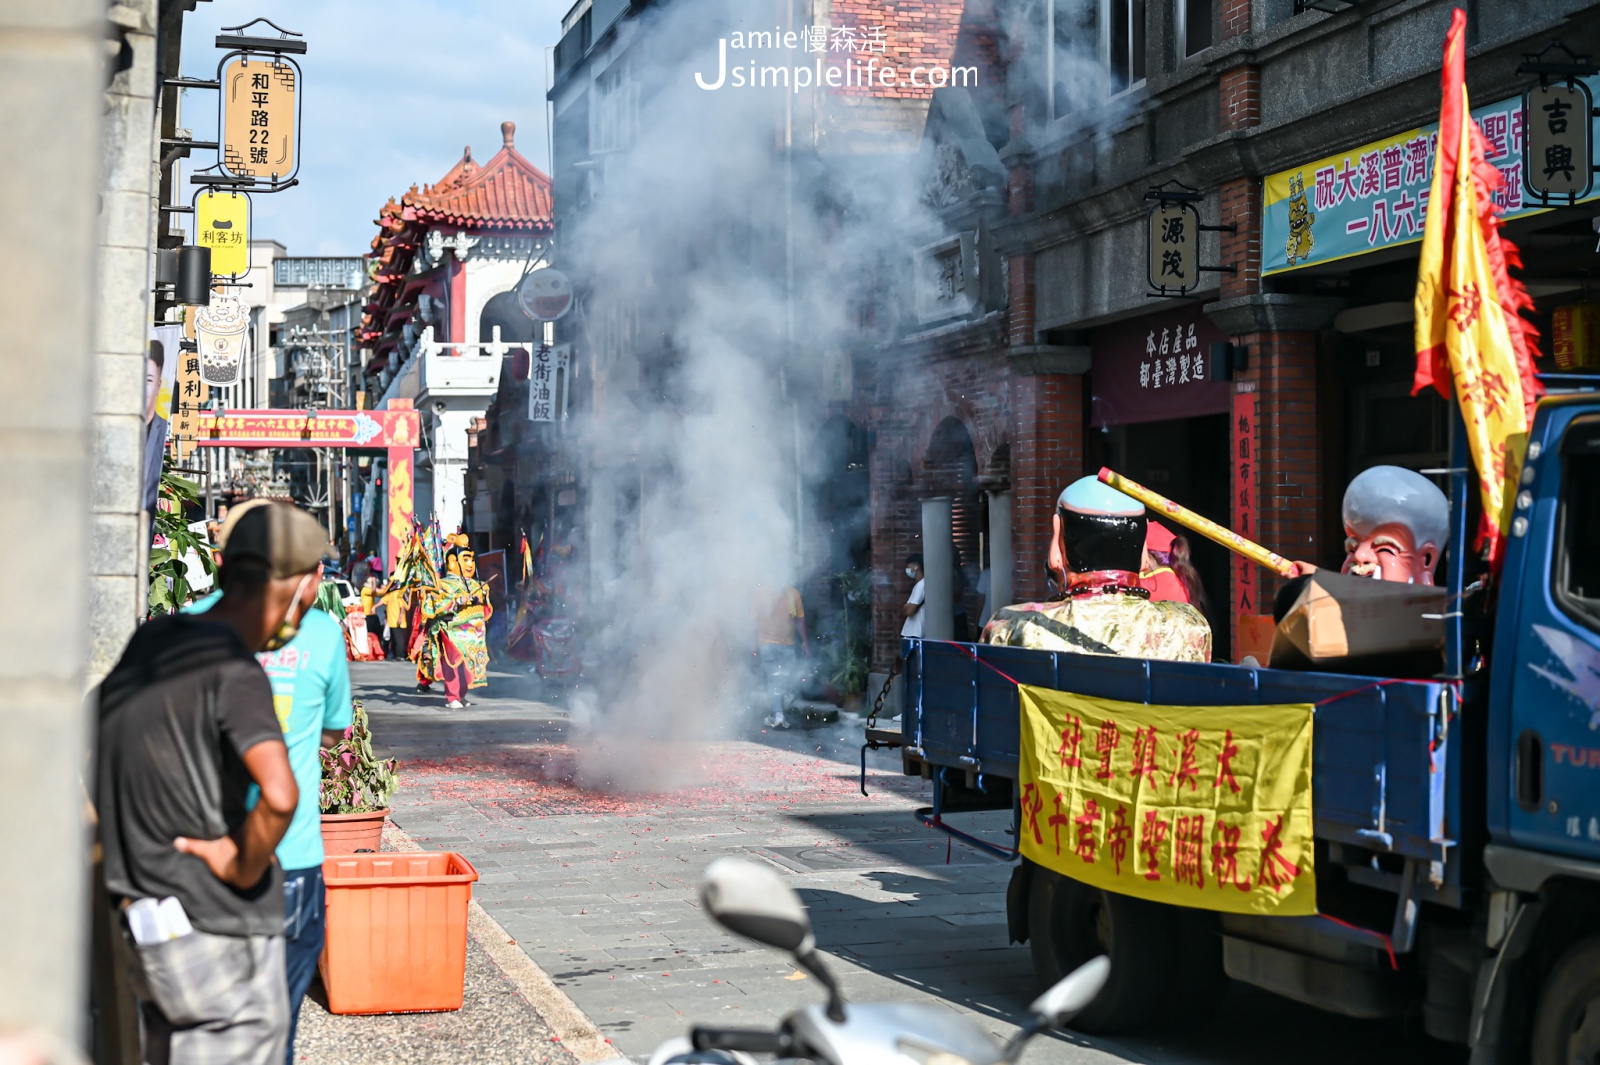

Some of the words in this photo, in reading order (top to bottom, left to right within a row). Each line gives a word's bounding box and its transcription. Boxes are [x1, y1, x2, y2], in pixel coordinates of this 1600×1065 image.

[250, 72, 269, 165] 和平路22號
[1542, 97, 1576, 182] 吉興
[201, 230, 243, 244] 利客坊
[1161, 217, 1186, 279] 源茂
[1145, 322, 1198, 358] 本店產品
[185, 358, 202, 398] 興利
[533, 344, 551, 420] 老街油飯
